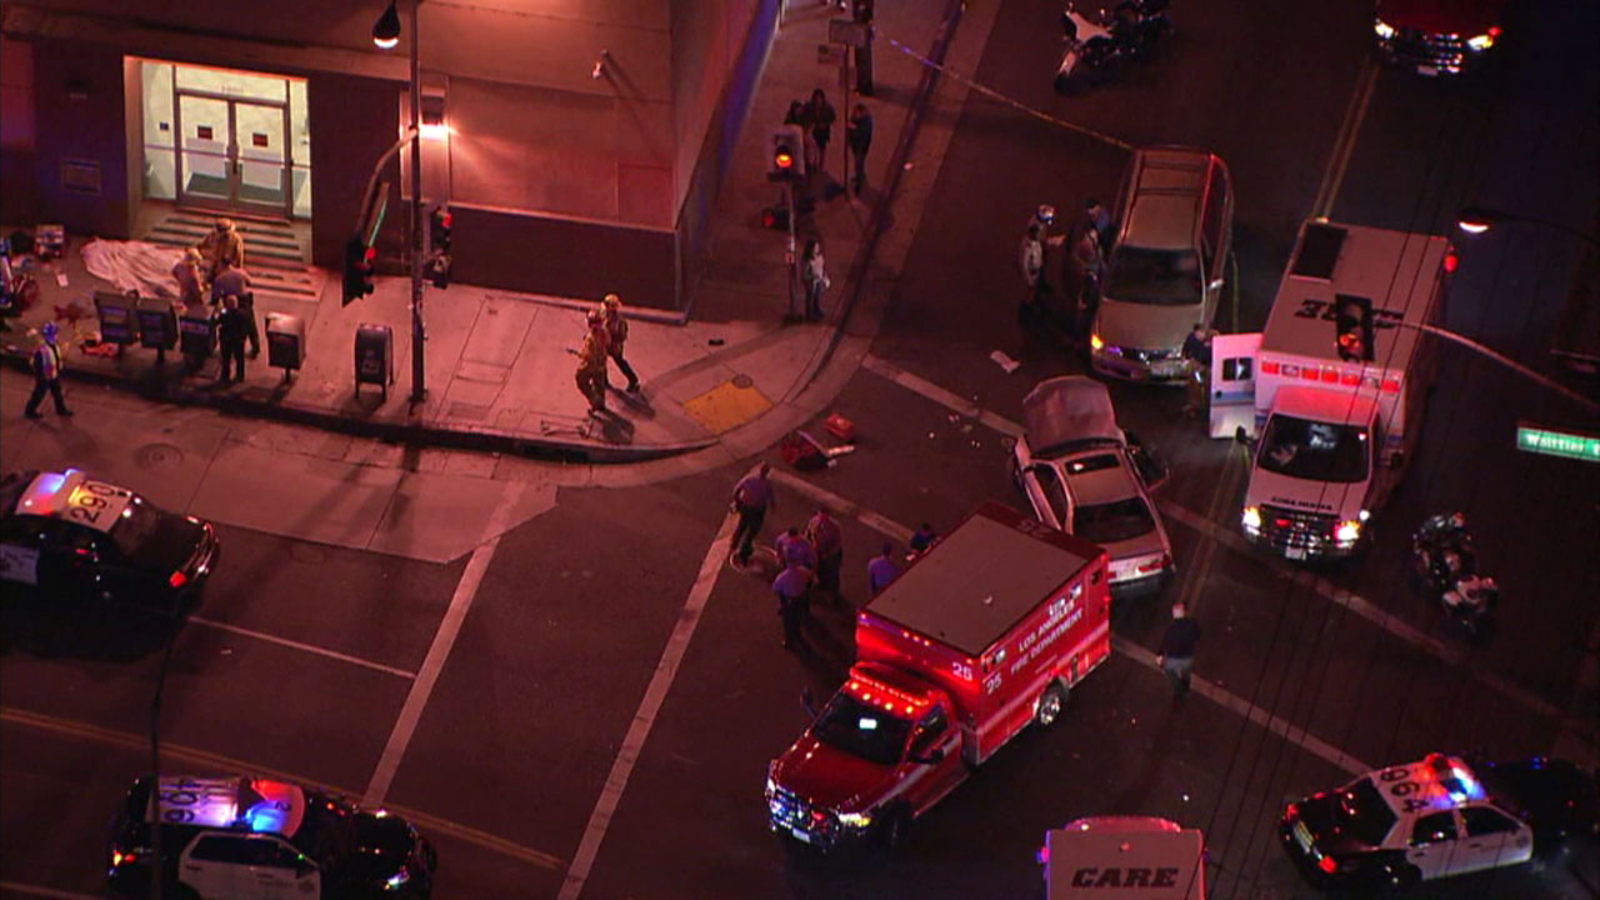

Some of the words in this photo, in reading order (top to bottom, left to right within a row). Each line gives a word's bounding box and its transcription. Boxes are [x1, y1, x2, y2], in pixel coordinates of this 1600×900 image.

[70, 484, 115, 524] 290
[1019, 631, 1036, 653] LOS
[1031, 607, 1083, 659] DEPARTMENT
[952, 661, 973, 681] 25
[987, 672, 1002, 695] 25
[1071, 867, 1179, 888] CARE
